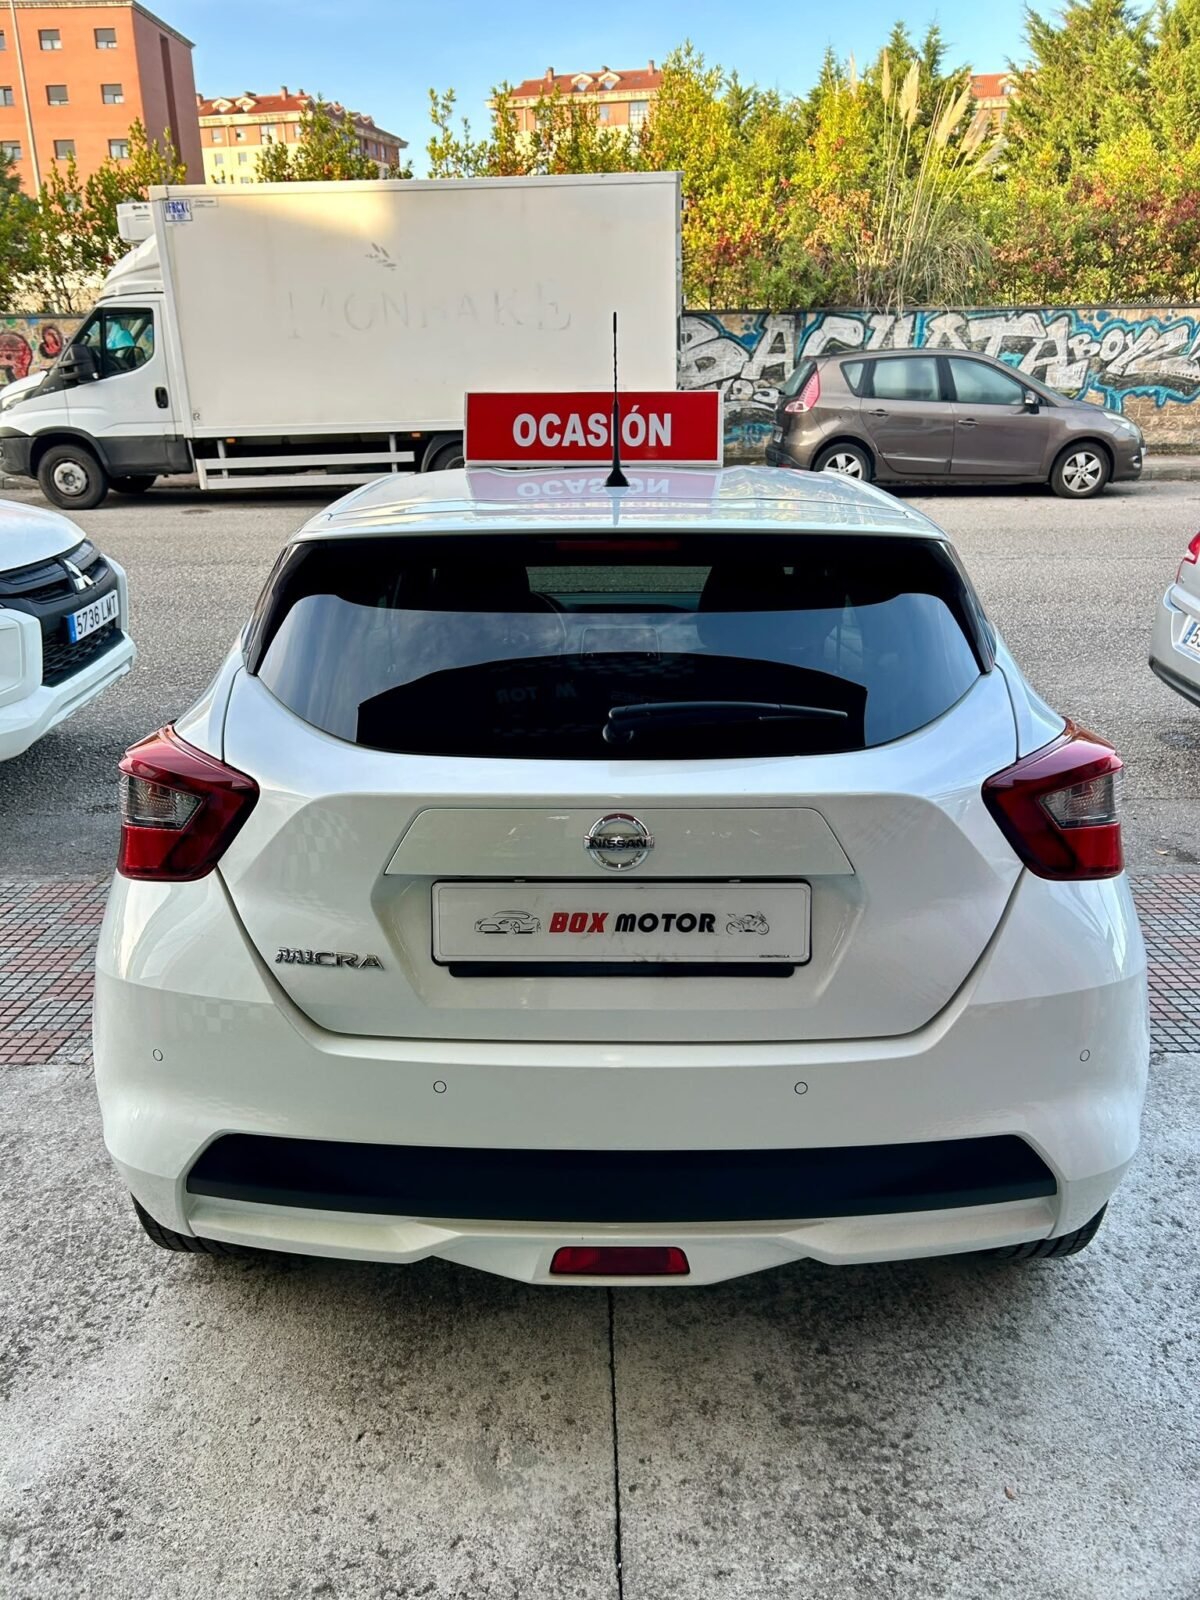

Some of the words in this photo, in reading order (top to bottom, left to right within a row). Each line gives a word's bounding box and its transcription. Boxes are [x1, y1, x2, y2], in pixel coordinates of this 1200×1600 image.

[512, 404, 672, 447] OCASÓN
[76, 606, 100, 635] 5736
[101, 595, 116, 621] LMT
[589, 837, 647, 850] NISSAN
[549, 912, 609, 933] BOX
[615, 912, 717, 933] MOTOR
[274, 947, 385, 970] MICRA
